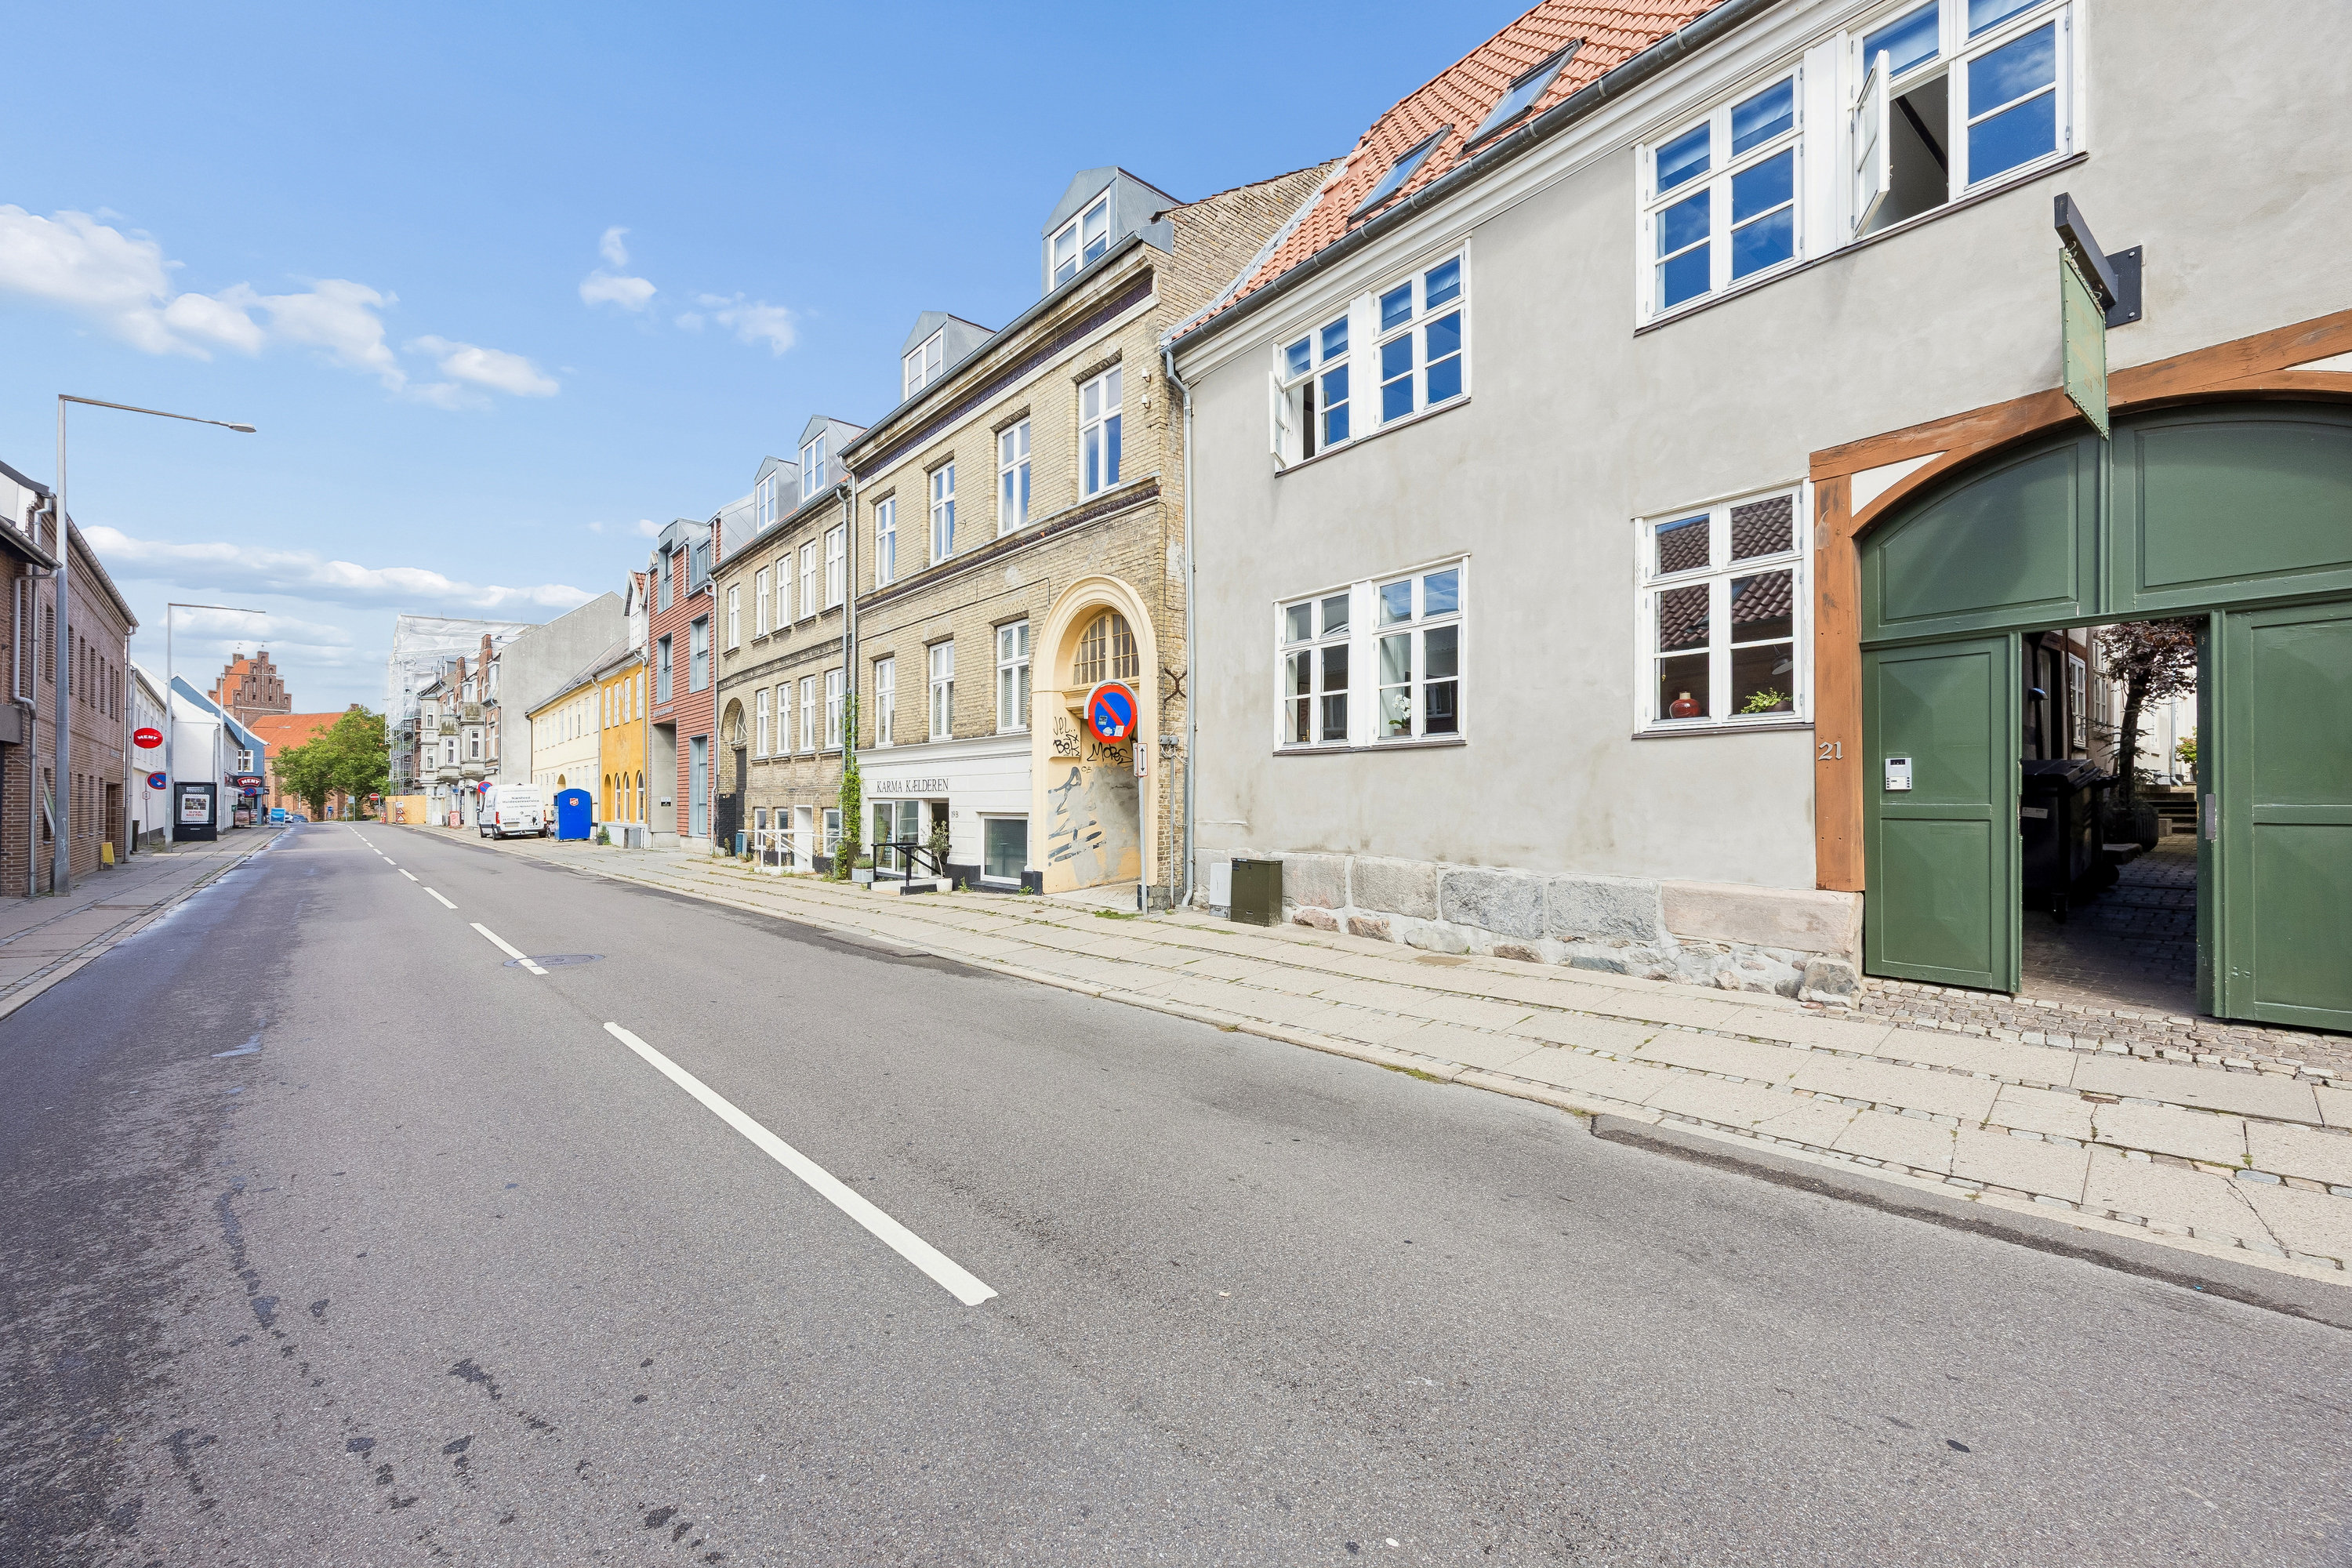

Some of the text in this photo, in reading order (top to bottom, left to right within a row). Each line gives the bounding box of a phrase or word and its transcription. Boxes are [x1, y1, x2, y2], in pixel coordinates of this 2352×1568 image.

[1818, 741, 1844, 760] 21
[877, 779, 949, 793] KARMA KÆLDEREN
